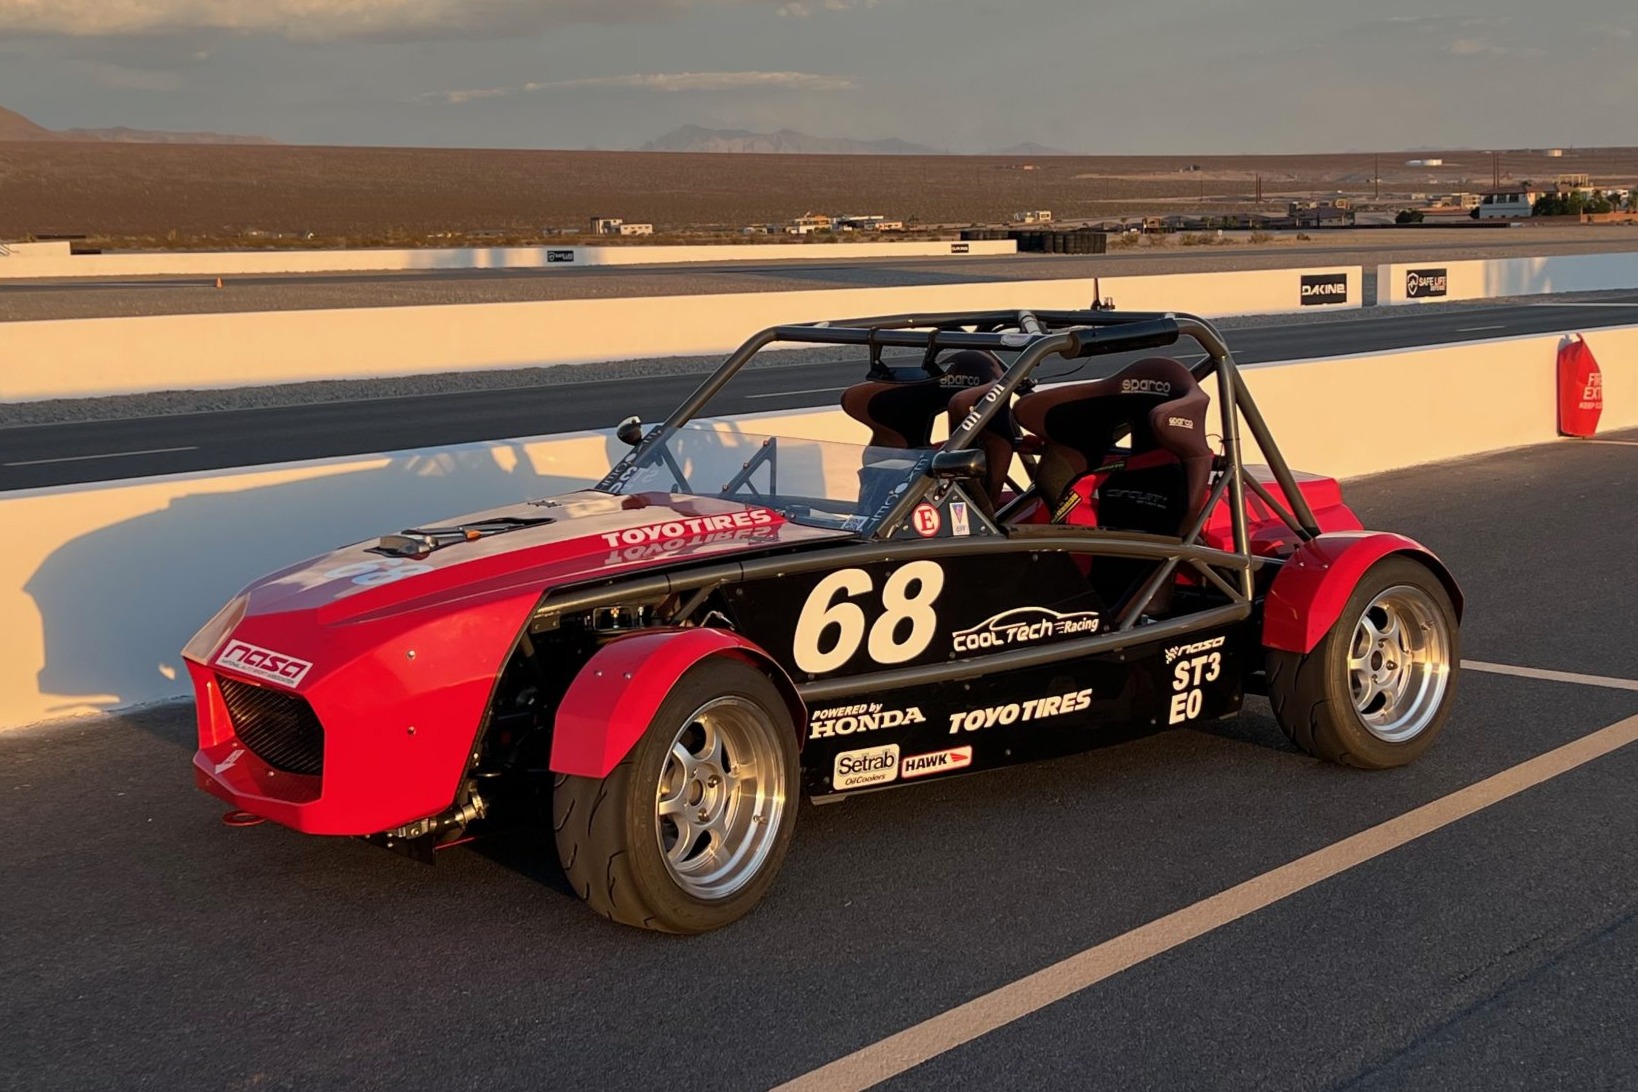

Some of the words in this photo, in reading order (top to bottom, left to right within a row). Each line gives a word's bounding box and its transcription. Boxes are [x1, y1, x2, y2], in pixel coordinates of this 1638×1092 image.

[1302, 283, 1346, 295] DAKINE
[1419, 276, 1434, 287] SAFE
[1122, 379, 1171, 394] sparco
[602, 522, 685, 548] TOYO
[685, 509, 772, 534] TIRES
[918, 509, 936, 532] E
[793, 560, 945, 673] 68
[953, 630, 1005, 652] COOL
[1064, 616, 1100, 633] Racing
[1177, 636, 1226, 656] nasa
[224, 644, 308, 679] nasa
[1172, 651, 1222, 691] ST3
[809, 707, 926, 740] HONDA
[811, 704, 868, 721] POWERED
[868, 702, 883, 714] by
[949, 703, 1021, 734] TOYO
[1021, 688, 1093, 721] TIRES
[838, 750, 895, 776] Setrab
[904, 752, 948, 772] HAWK
